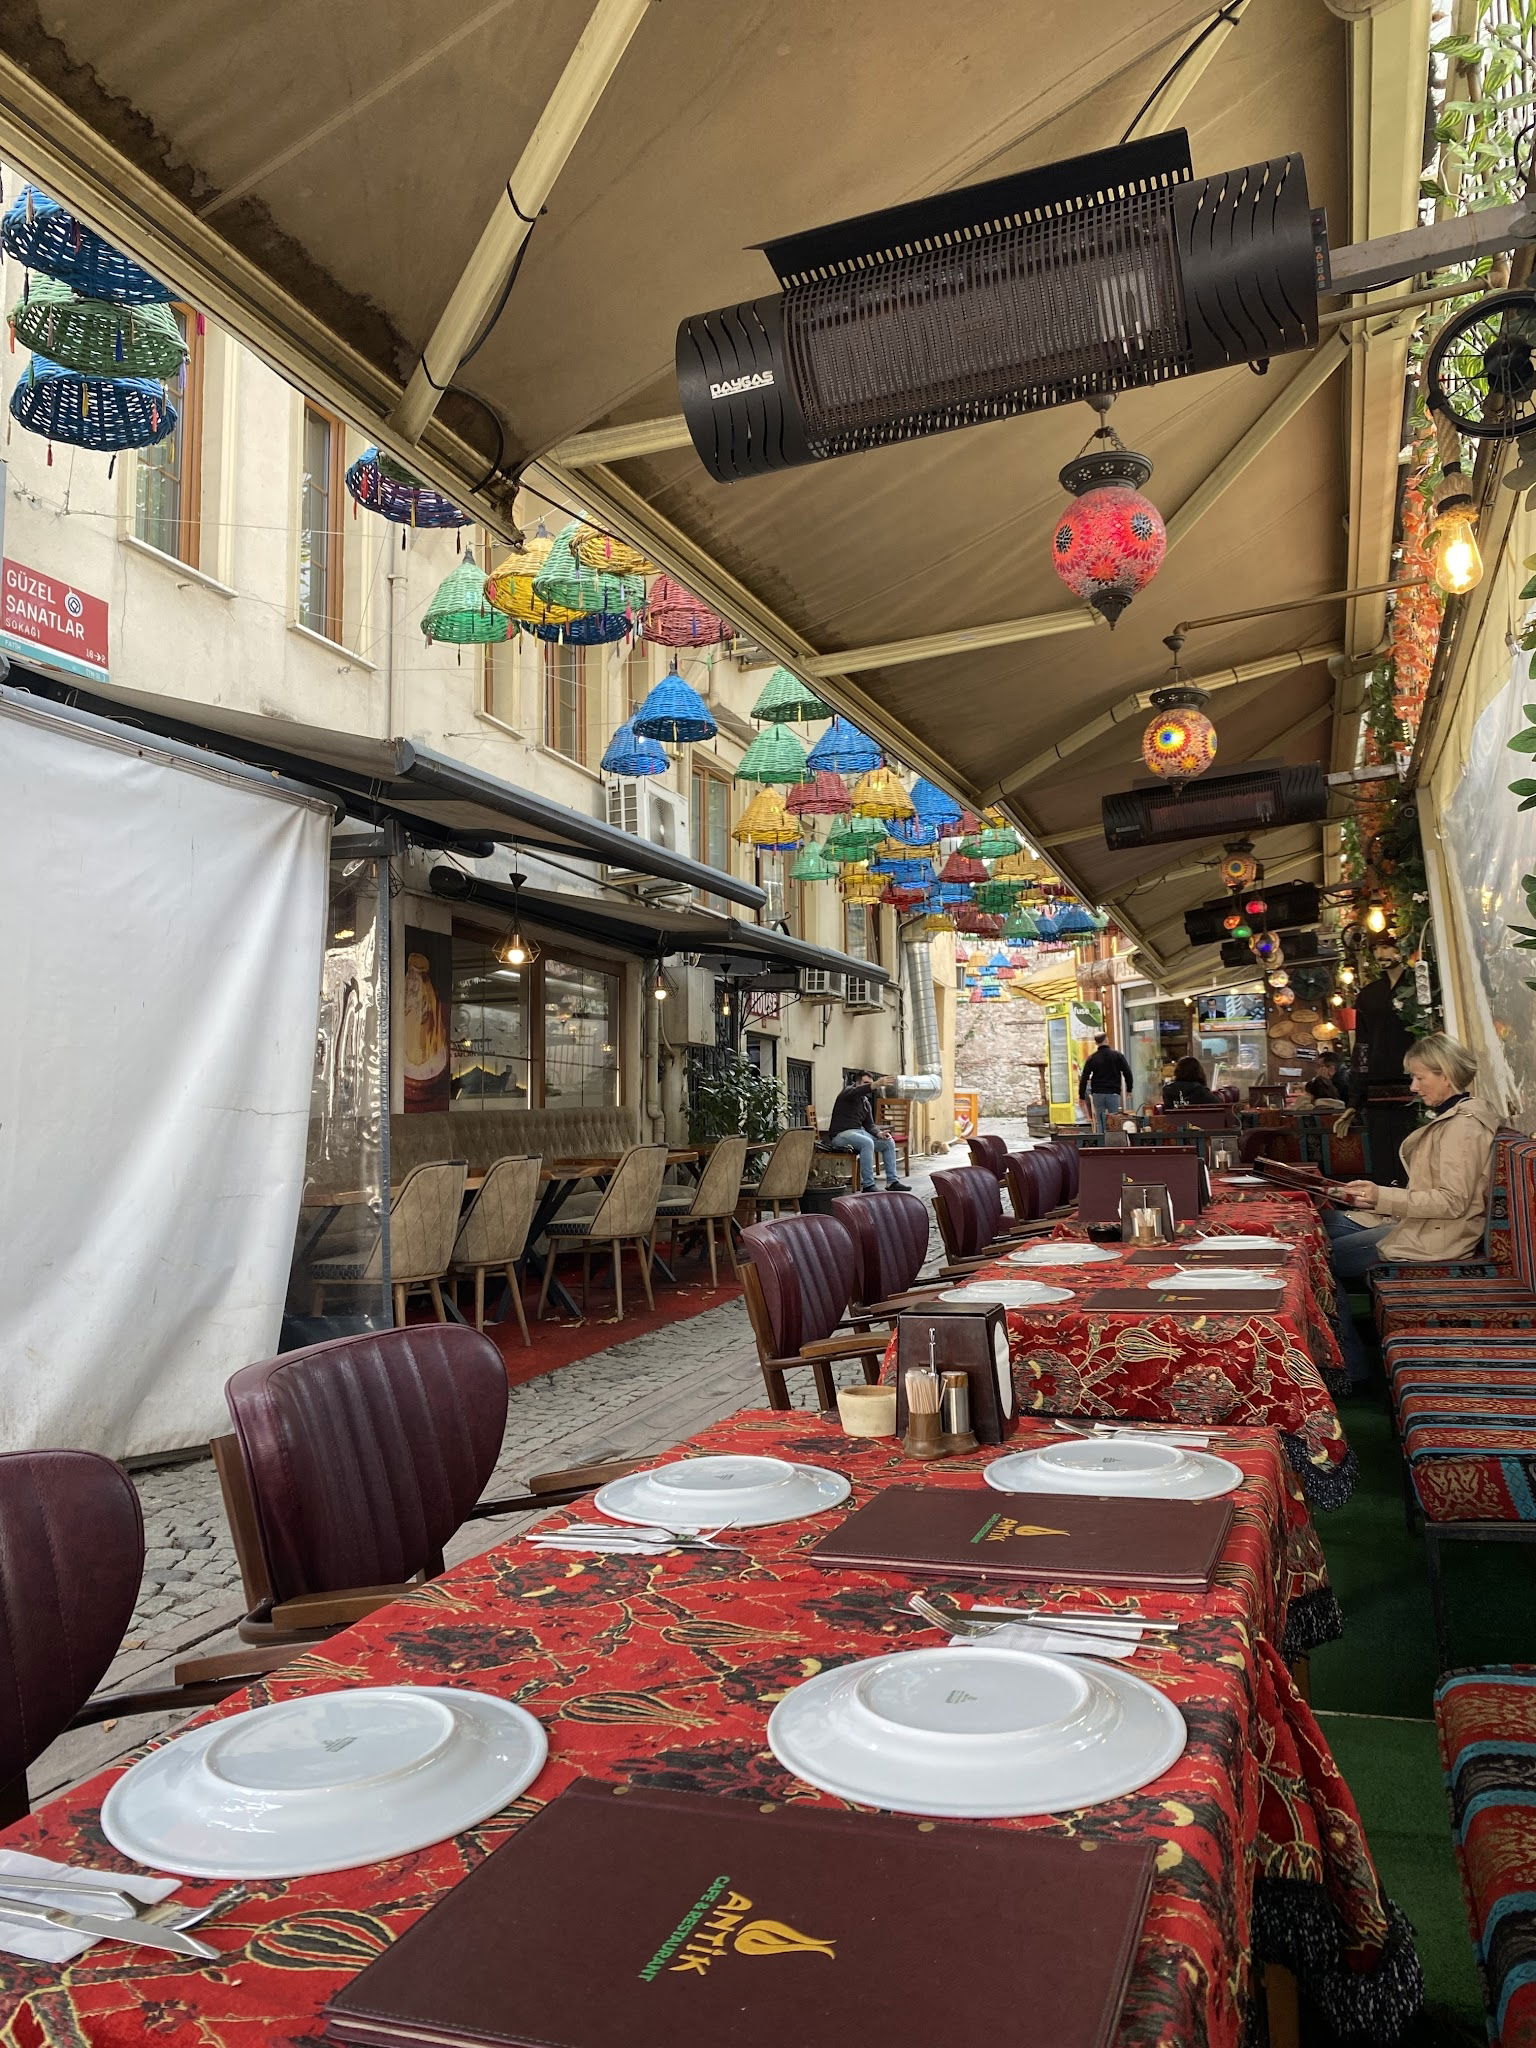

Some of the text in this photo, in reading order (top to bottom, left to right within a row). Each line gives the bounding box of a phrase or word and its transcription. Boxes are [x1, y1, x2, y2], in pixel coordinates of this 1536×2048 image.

[709, 370, 775, 398] DAYGAS
[6, 569, 56, 604] GÜZEL
[5, 617, 41, 640] SOKAĞI
[6, 594, 85, 641] SANATLAR
[637, 1875, 731, 1982] CAFE & RESTAURANT
